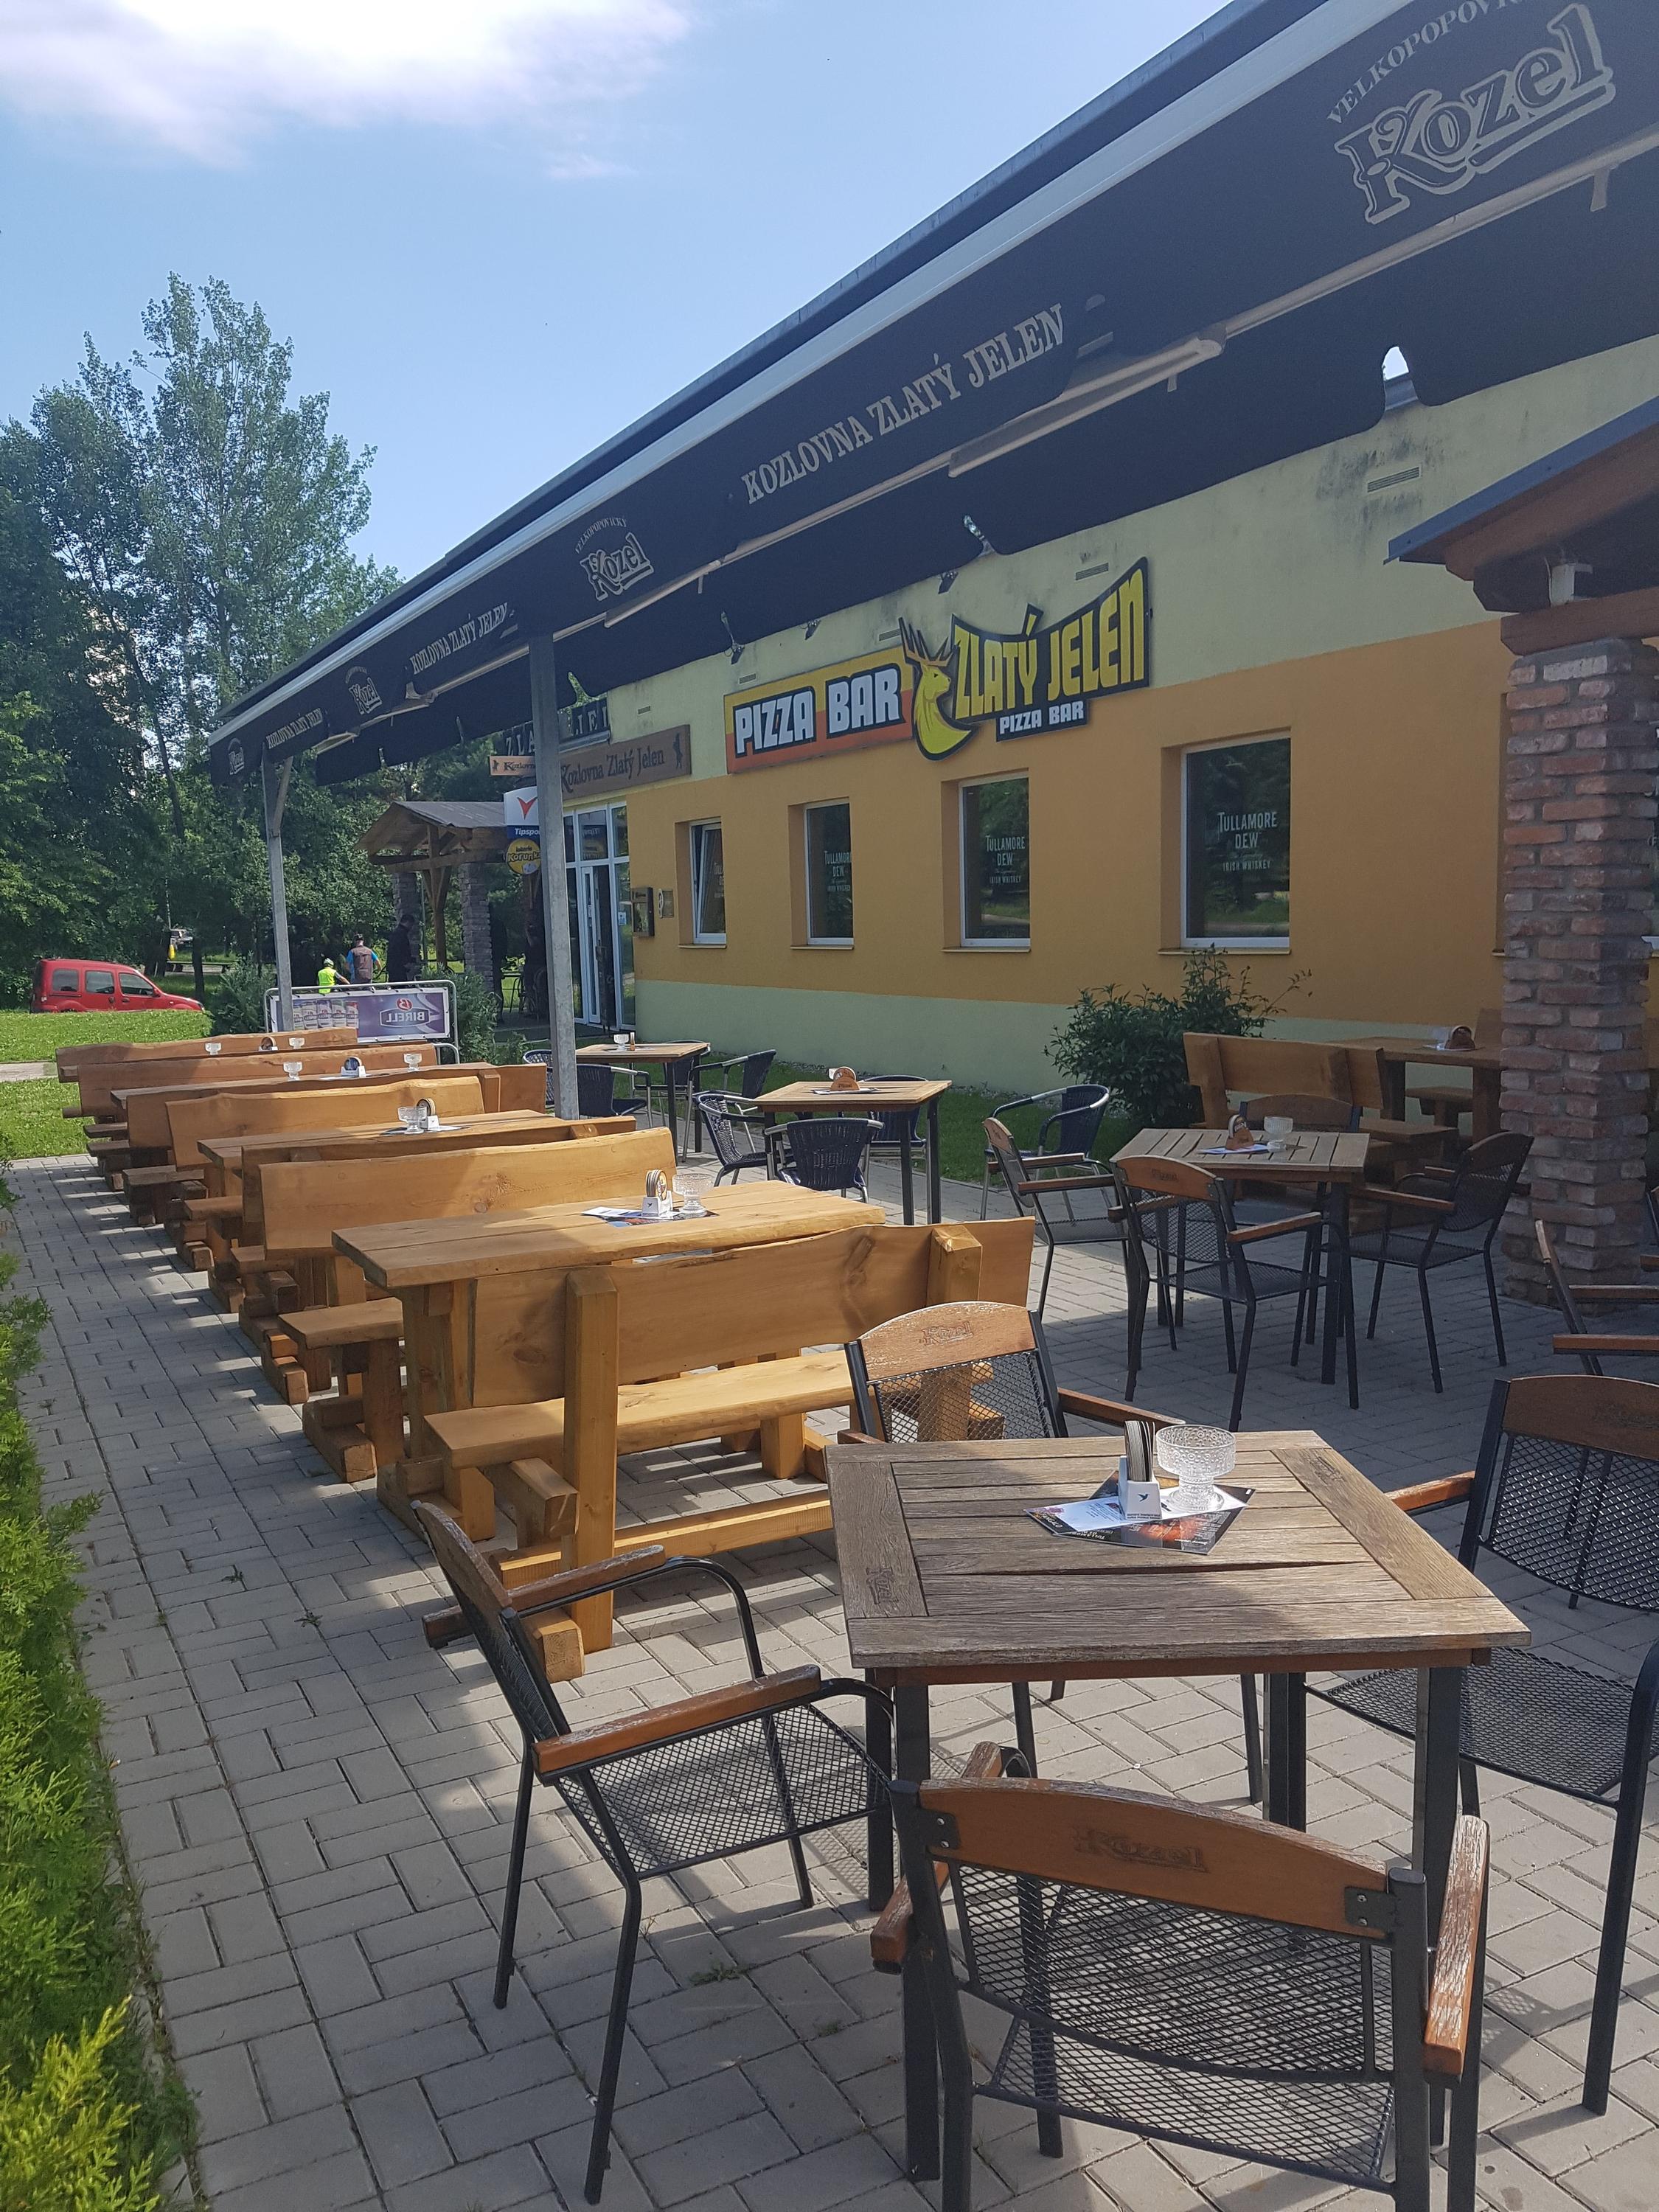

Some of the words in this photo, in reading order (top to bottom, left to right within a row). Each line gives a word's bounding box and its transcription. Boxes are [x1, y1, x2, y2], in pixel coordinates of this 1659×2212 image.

[1335, 3, 1616, 224] Kozel
[740, 415, 873, 504] KOZLOVNA
[866, 352, 961, 436] ZLATÝ
[962, 302, 1064, 388] JELEN
[580, 532, 654, 601] Kozel
[409, 636, 452, 675] KOZLOVNA
[448, 613, 476, 653] ZLATÝ
[478, 602, 508, 638] JELEN
[954, 614, 1037, 720] ZLATÝ
[1048, 568, 1145, 701] JELEN
[735, 690, 814, 754] PIZZA
[828, 667, 902, 734] BAR
[999, 709, 1043, 734] PIZZA
[1048, 700, 1085, 725] BAR
[560, 762, 604, 793] Kozlovna
[607, 748, 635, 780] Zlatý
[637, 745, 665, 776] Jelen
[985, 835, 1026, 852] TULLAMORE
[1217, 811, 1278, 832] TULLAMORE
[1235, 832, 1259, 849] DEW
[997, 852, 1014, 866] DEW
[1222, 862, 1239, 872] IRISH
[1242, 860, 1271, 871] WHISKEY
